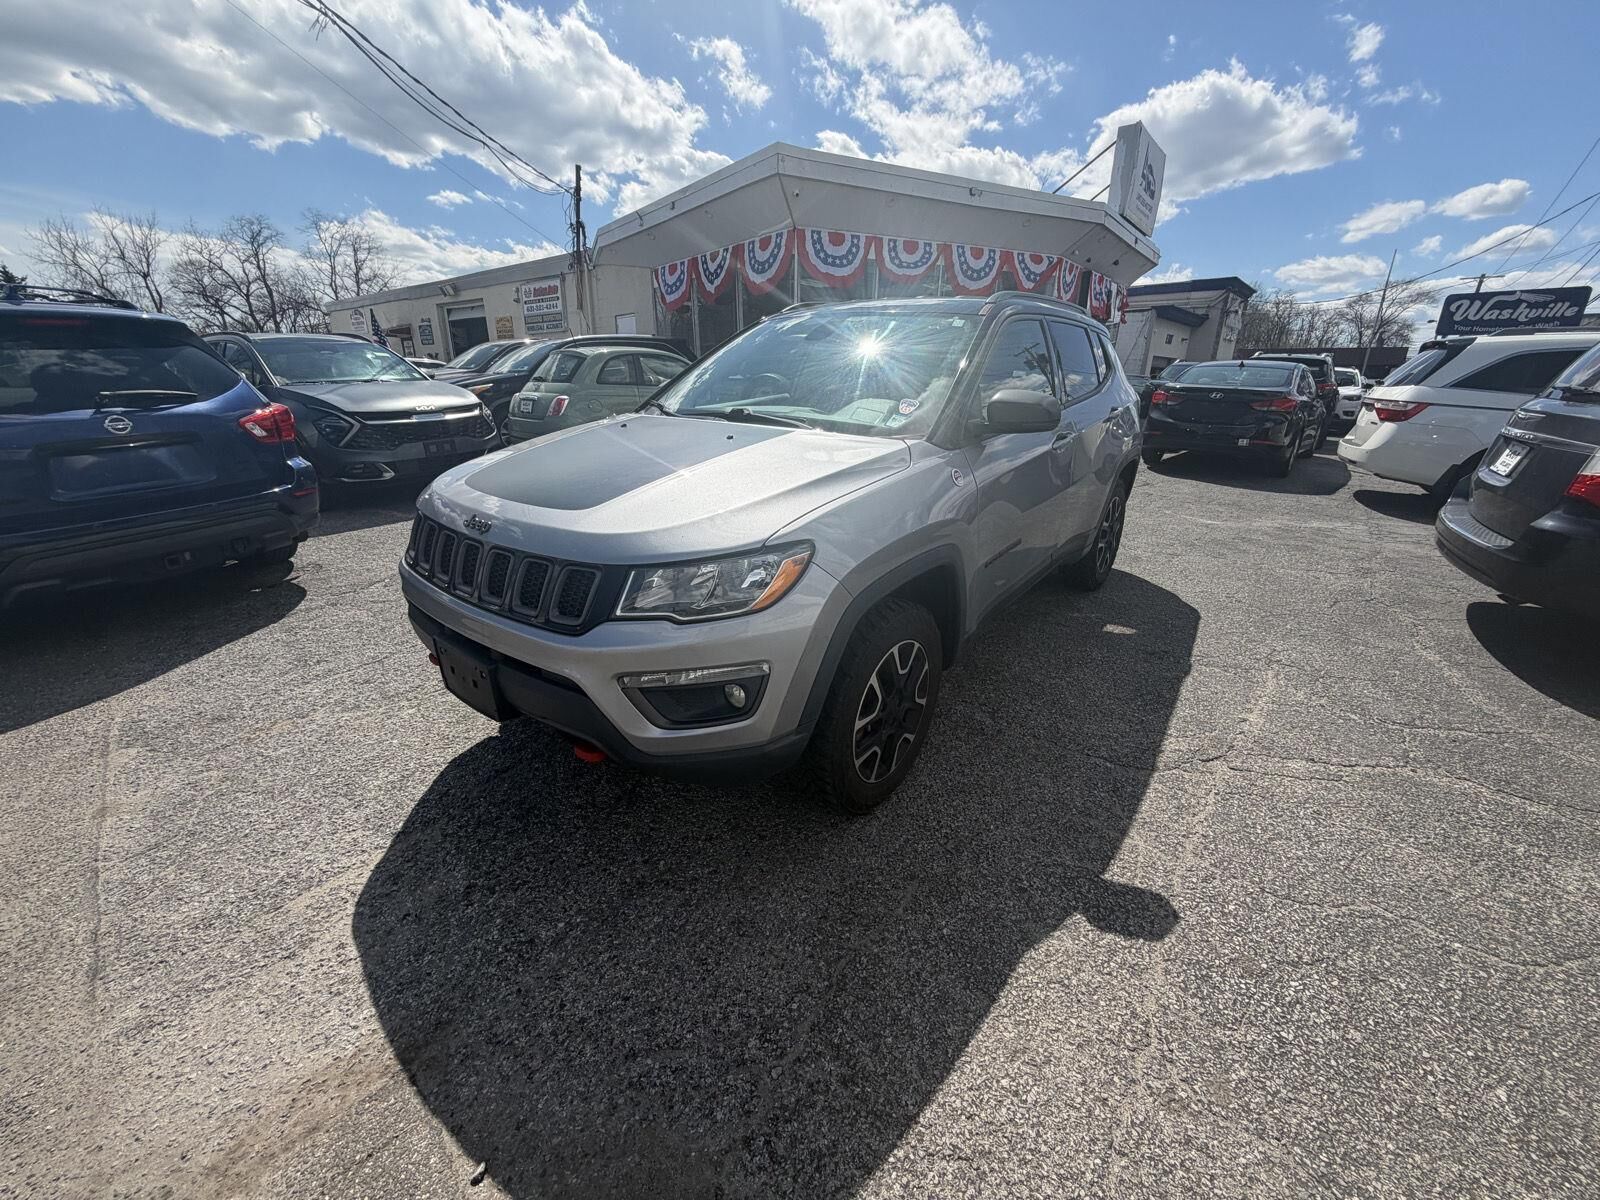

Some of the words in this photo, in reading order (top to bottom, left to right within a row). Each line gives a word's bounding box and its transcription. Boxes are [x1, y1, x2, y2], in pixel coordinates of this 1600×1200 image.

[1450, 291, 1579, 322] Washville
[1453, 324, 1471, 332] Your
[463, 514, 492, 535] Jeep
